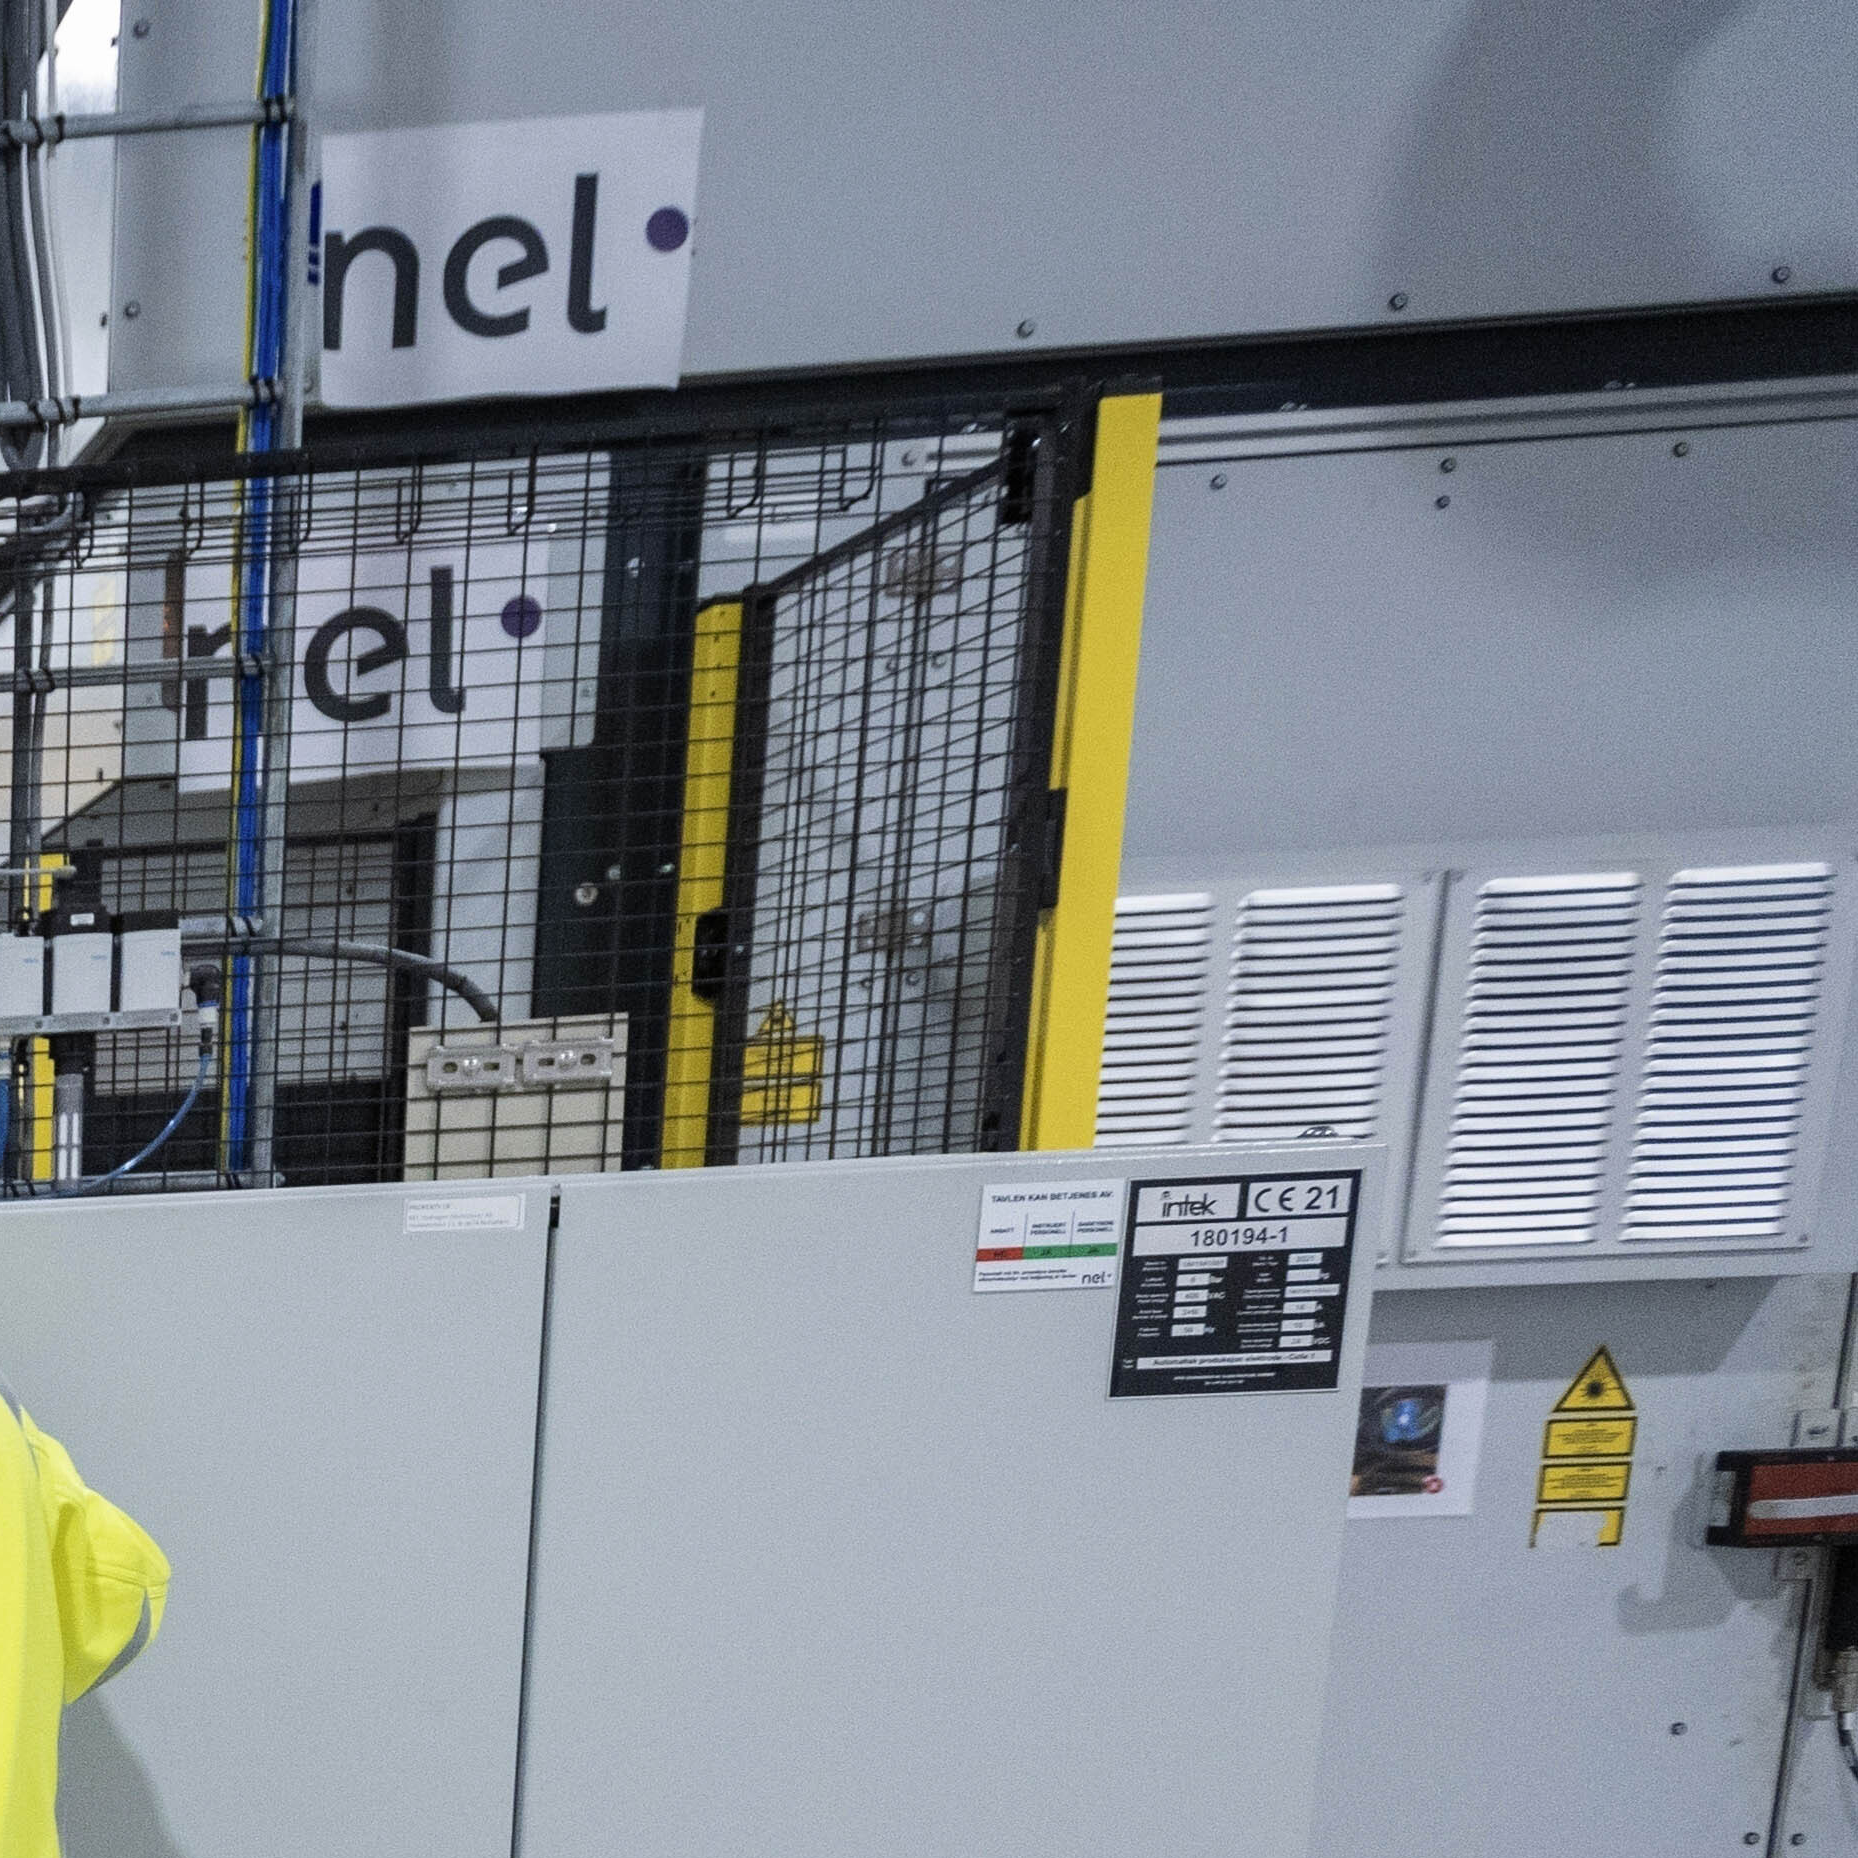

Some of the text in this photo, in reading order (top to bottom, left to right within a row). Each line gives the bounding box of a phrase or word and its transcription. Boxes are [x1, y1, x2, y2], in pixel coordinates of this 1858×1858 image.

[323, 173, 607, 350] nel
[1161, 1190, 1217, 1217] intek
[1304, 1184, 1339, 1211] 21
[1191, 1227, 1288, 1247] 180194-1
[1082, 1271, 1105, 1284] nel
